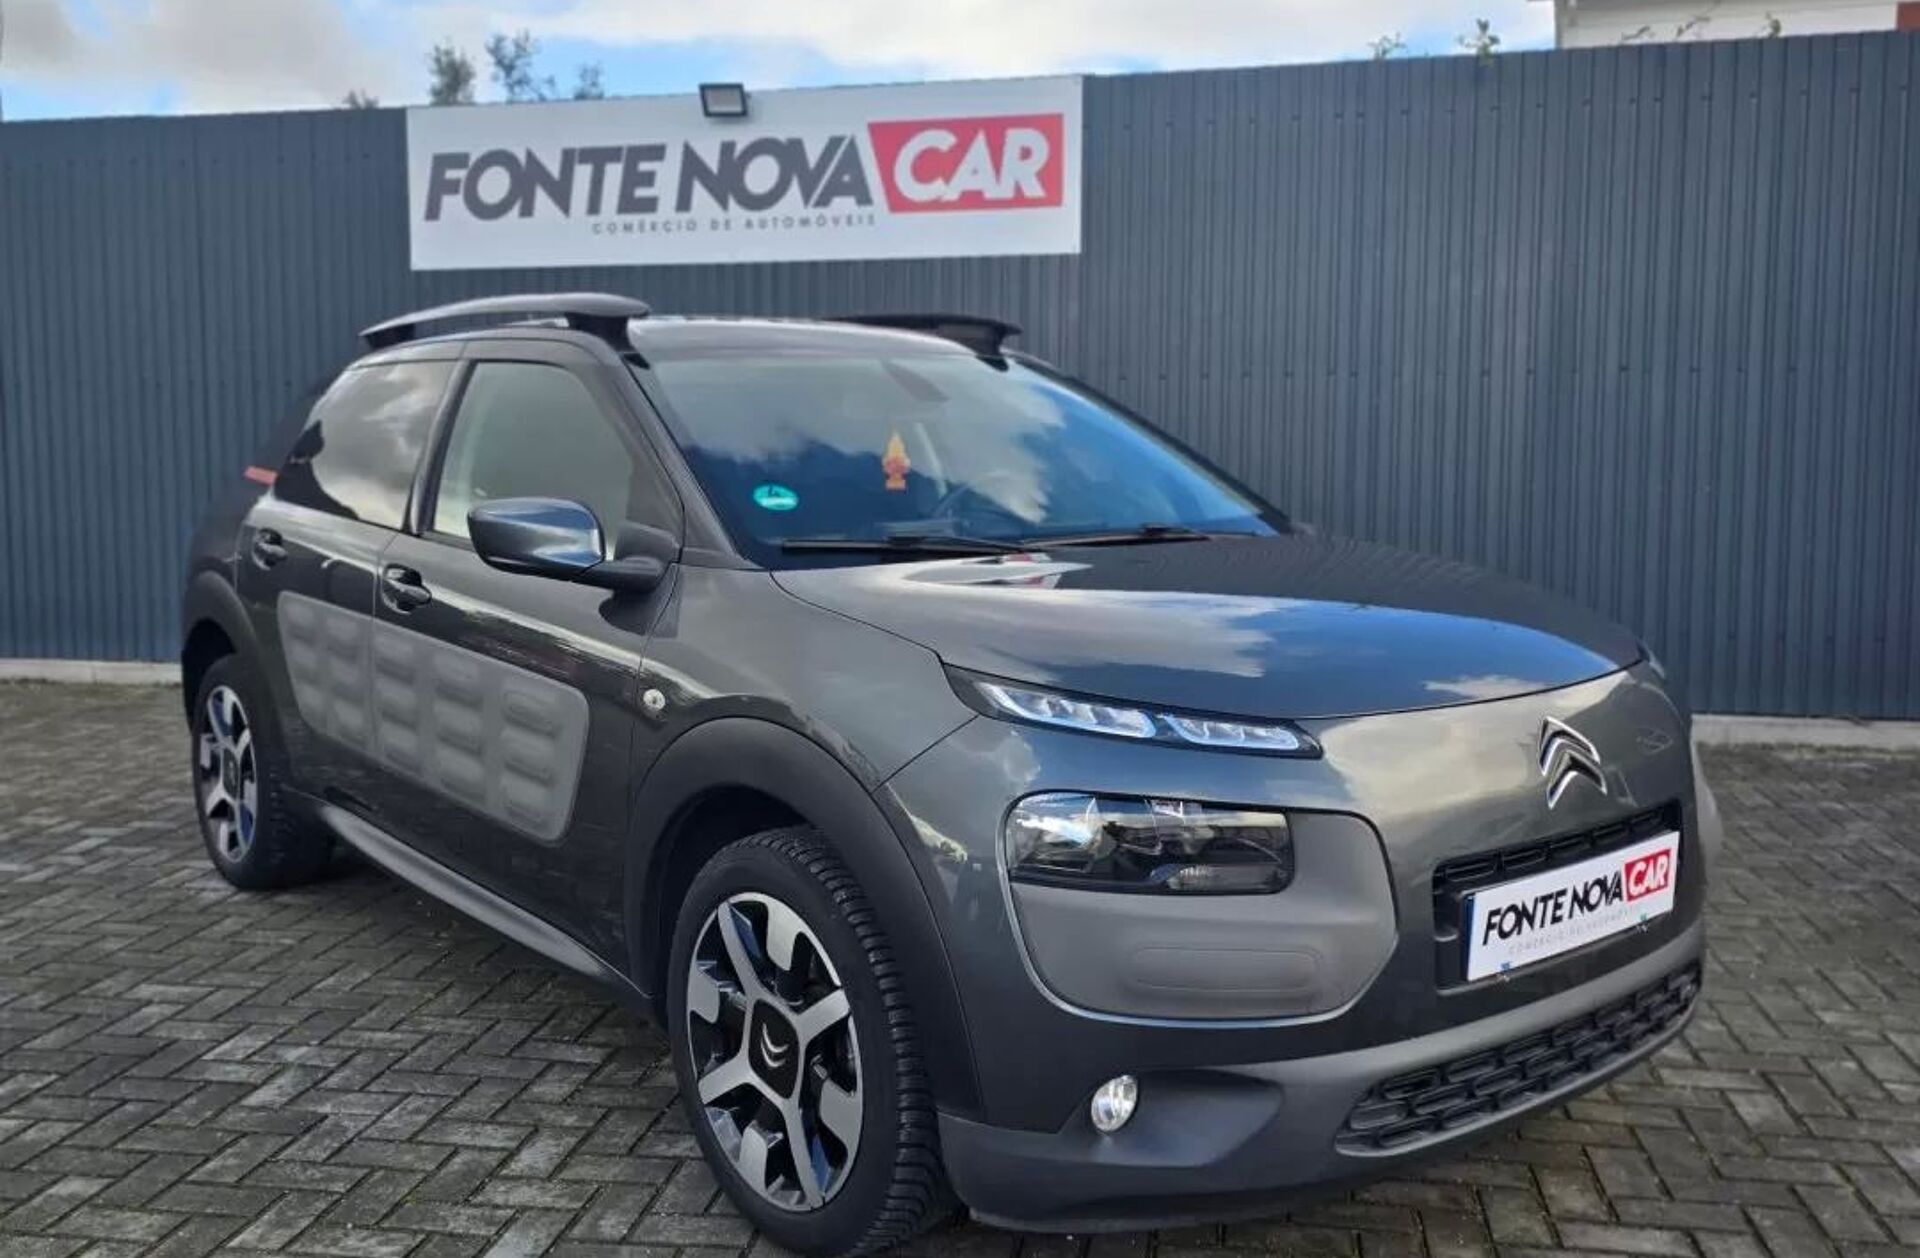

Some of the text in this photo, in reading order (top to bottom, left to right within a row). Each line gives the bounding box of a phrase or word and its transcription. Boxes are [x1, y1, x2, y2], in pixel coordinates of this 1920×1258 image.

[424, 127, 1050, 222] FONTE NOVA CAR
[710, 218, 732, 231] DE
[1483, 889, 1567, 945] FONTE
[1569, 871, 1622, 918] NOVA
[1628, 855, 1668, 895] CAR
